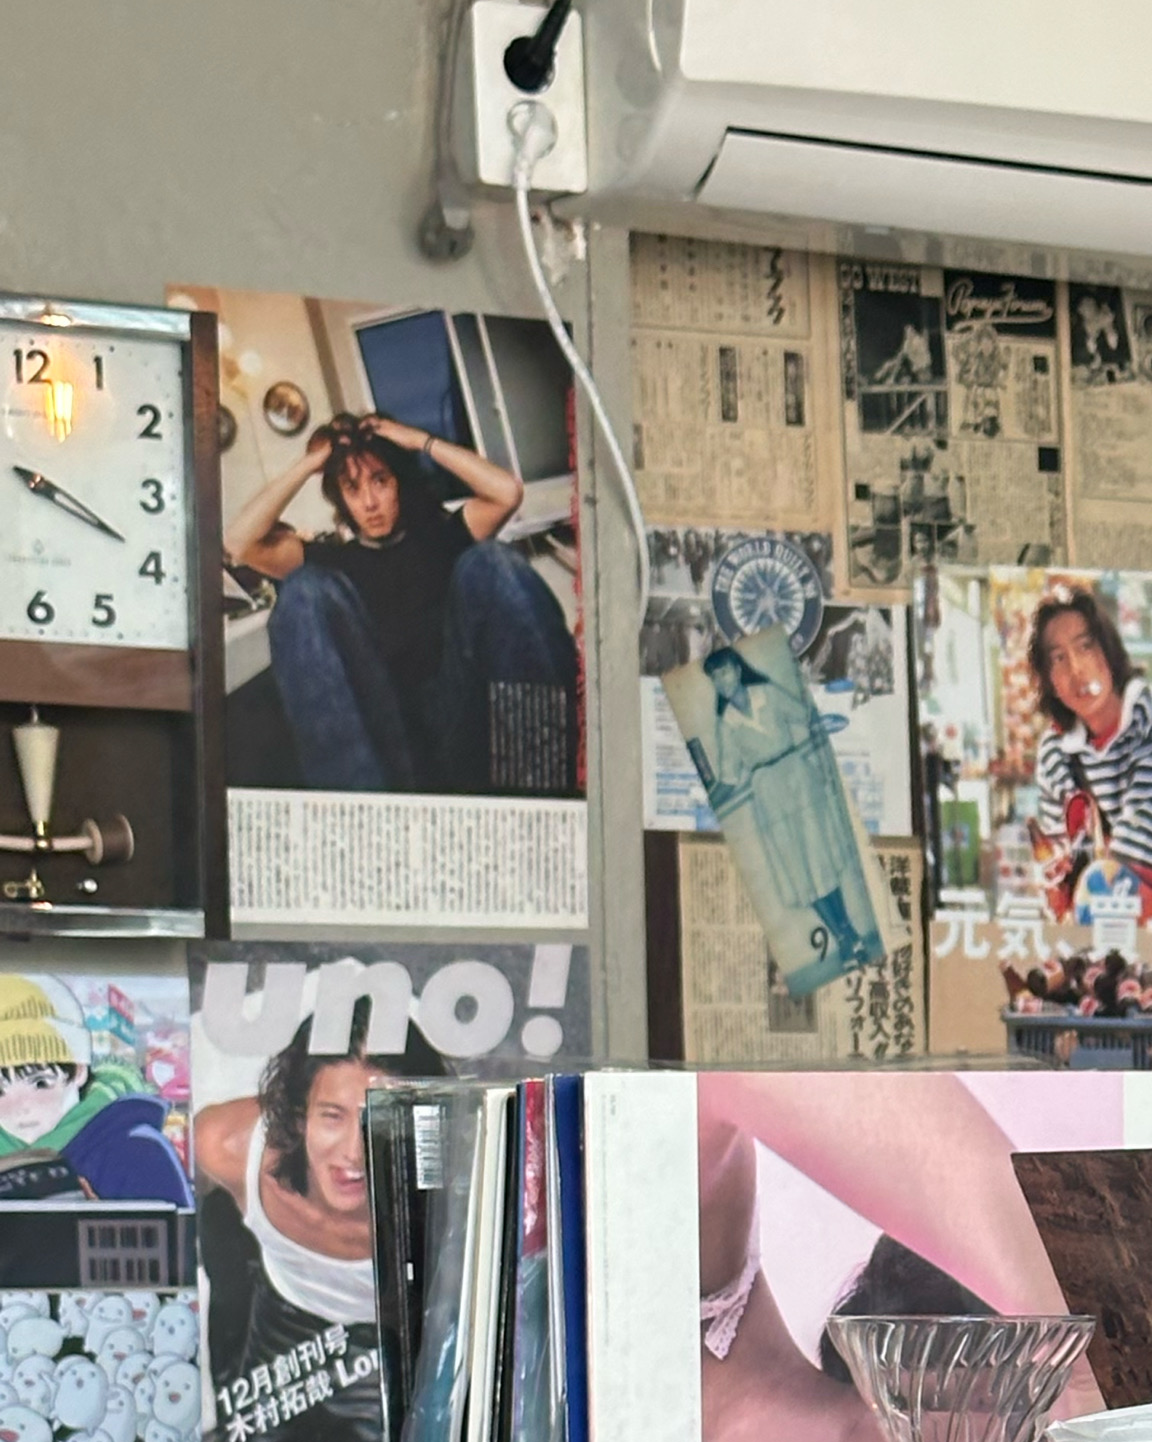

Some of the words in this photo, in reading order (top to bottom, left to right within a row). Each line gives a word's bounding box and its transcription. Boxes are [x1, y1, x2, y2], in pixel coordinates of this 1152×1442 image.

[13, 349, 53, 384] 12
[94, 355, 104, 391] 1
[137, 404, 163, 440] 2
[140, 478, 166, 515] 3
[138, 551, 166, 585] 4
[27, 590, 55, 625] 6
[91, 594, 117, 628] 5
[810, 926, 829, 962] 9
[201, 943, 573, 1060] uno!
[217, 1323, 350, 1416] 12月創刊号
